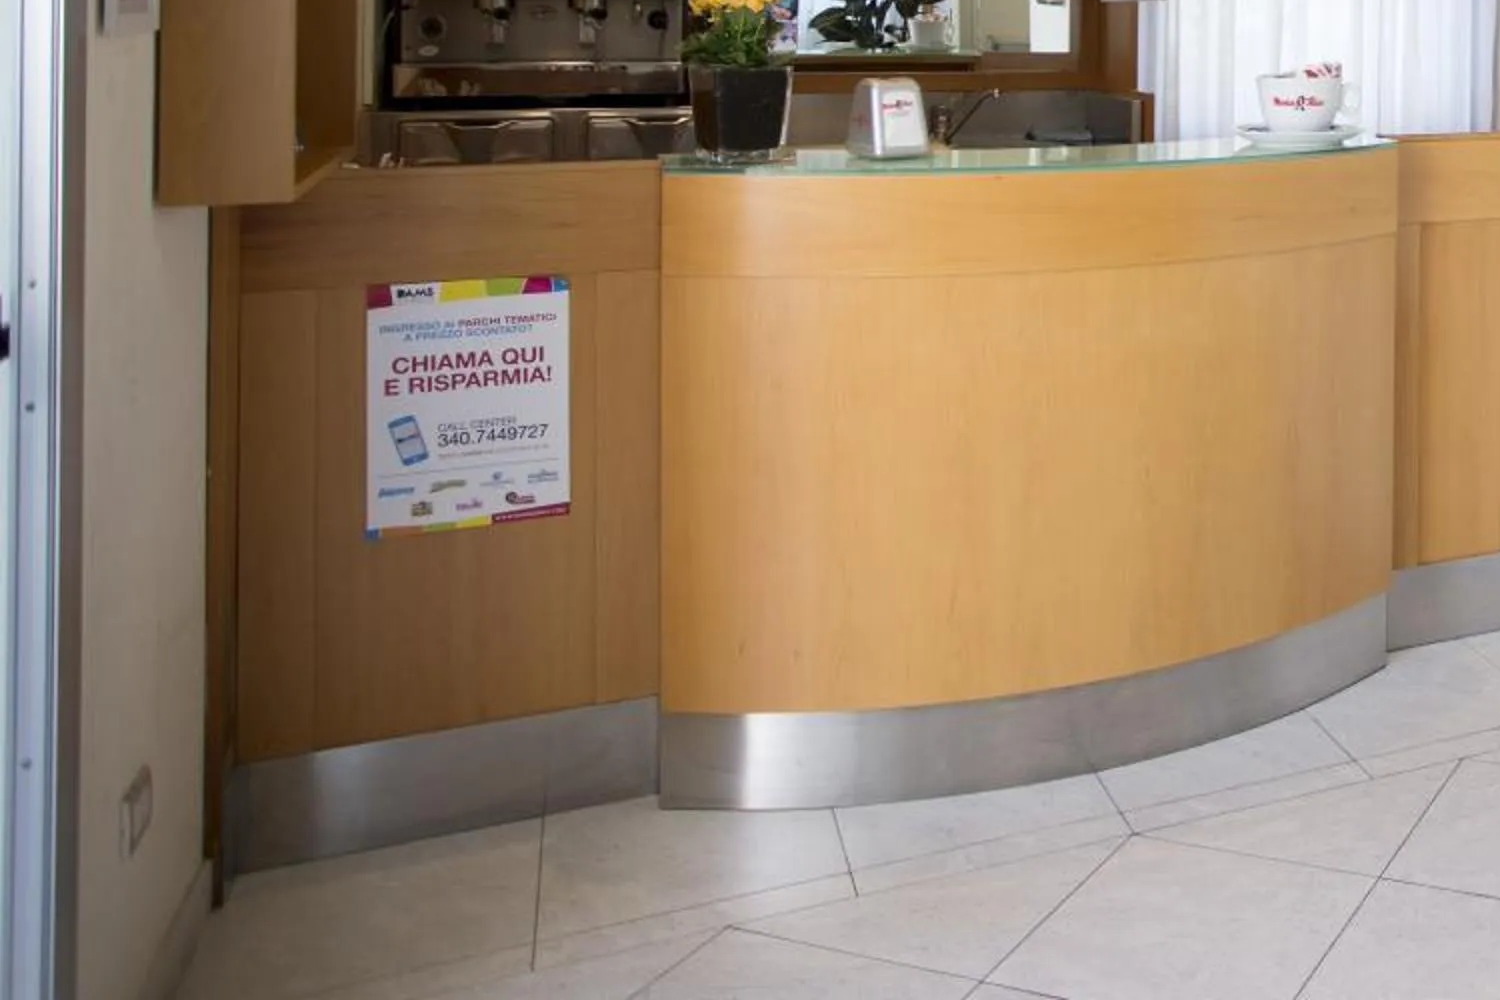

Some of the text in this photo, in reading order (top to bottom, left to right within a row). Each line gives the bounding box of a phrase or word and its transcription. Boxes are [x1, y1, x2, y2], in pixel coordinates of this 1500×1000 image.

[457, 316, 501, 328] PARCHI
[504, 312, 558, 325] TEMATICI
[391, 346, 545, 375] CHIAMA QUI
[384, 366, 552, 397] E RISPARMIA!
[437, 423, 549, 449] 340.7449727
